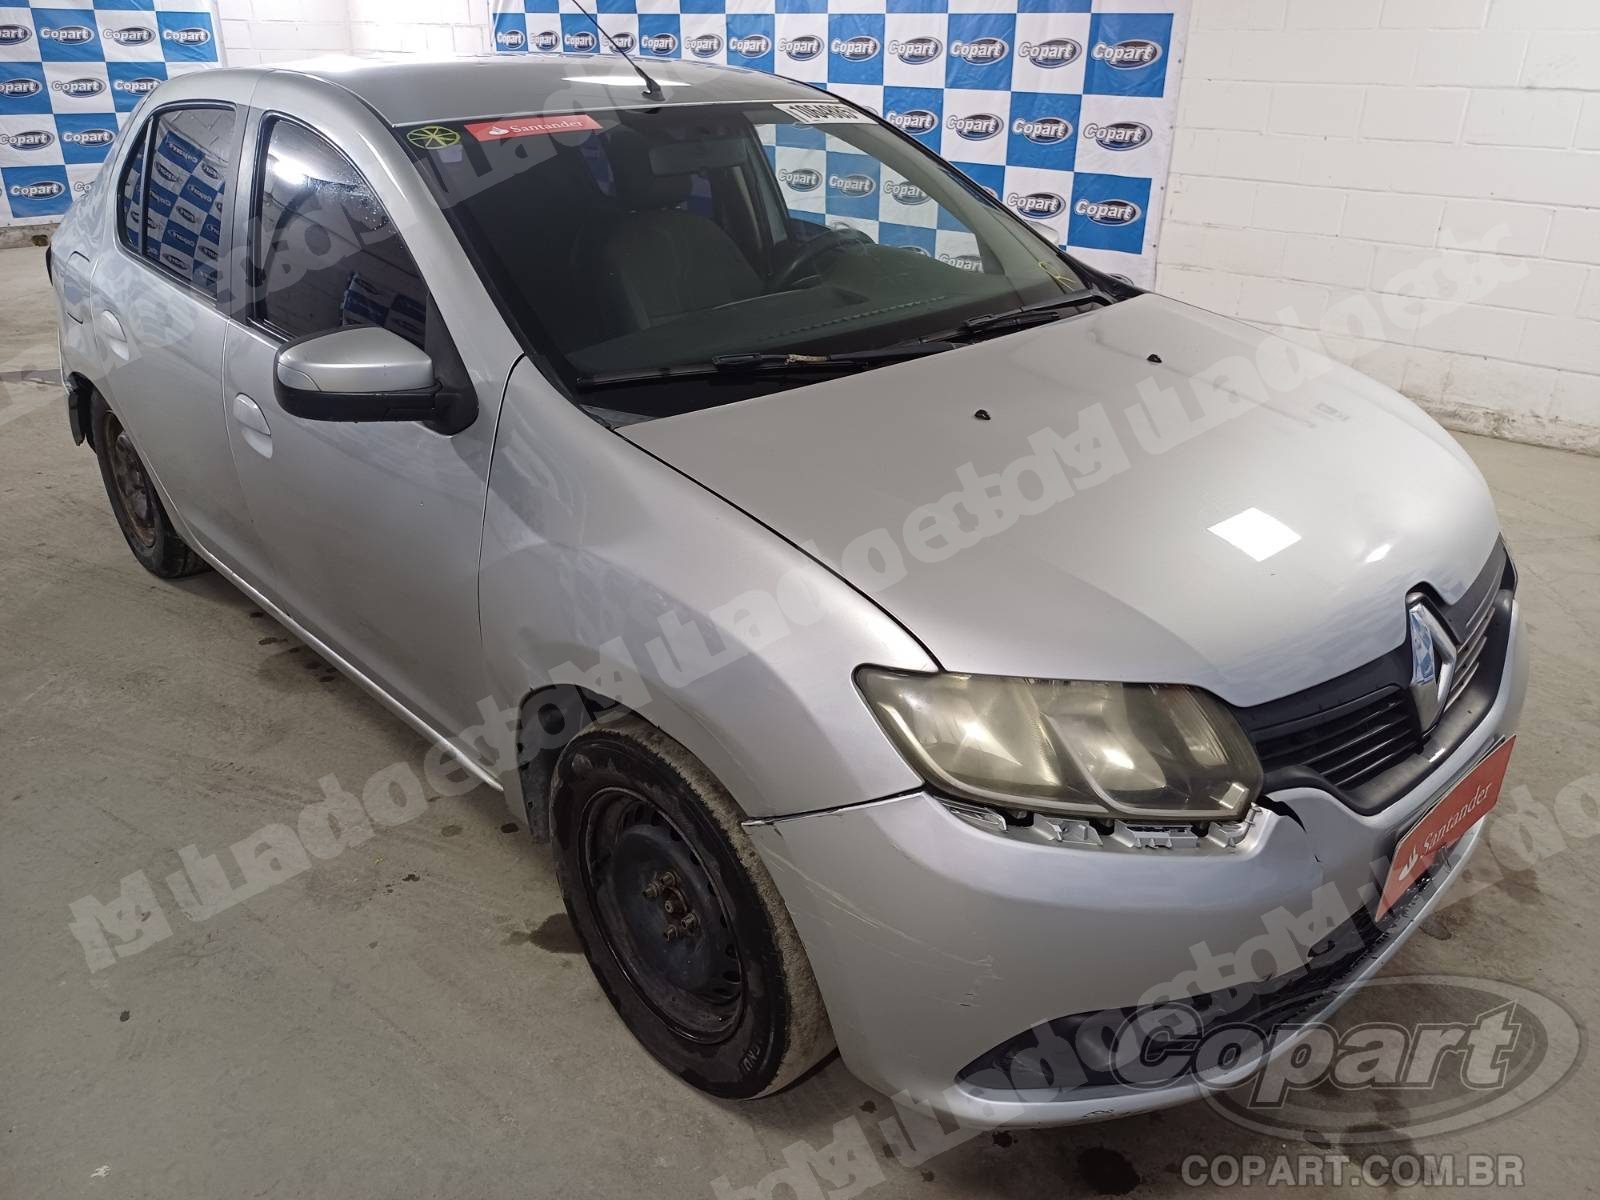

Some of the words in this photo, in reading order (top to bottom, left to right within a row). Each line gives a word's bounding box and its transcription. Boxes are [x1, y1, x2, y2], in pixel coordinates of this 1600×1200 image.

[40, 27, 90, 41] Copart
[103, 29, 149, 42] Copart
[163, 29, 206, 43] Copart
[496, 32, 523, 46] Copart
[530, 33, 556, 46] Copart
[564, 34, 593, 48] Copart
[641, 35, 674, 50] Copart
[685, 37, 719, 52] Copart
[729, 37, 767, 54] Copart
[778, 39, 818, 56] Copart
[831, 40, 875, 56] Copart
[888, 39, 936, 57] Copart
[951, 41, 1002, 58] Copart
[1018, 42, 1074, 62] Copart
[1092, 43, 1154, 64] Copart
[52, 81, 101, 94] Copart
[510, 119, 584, 133] Santander
[886, 111, 932, 129] Copart
[946, 115, 996, 133] Copart
[1012, 118, 1066, 138] Copart
[63, 131, 110, 144] Copart
[1084, 123, 1143, 144] Copart
[778, 169, 818, 186] Copart
[829, 174, 871, 192] Copart
[11, 184, 60, 197] Copart
[1007, 192, 1059, 213] Copart
[1075, 199, 1136, 222] Copart
[1423, 783, 1493, 853] Santander
